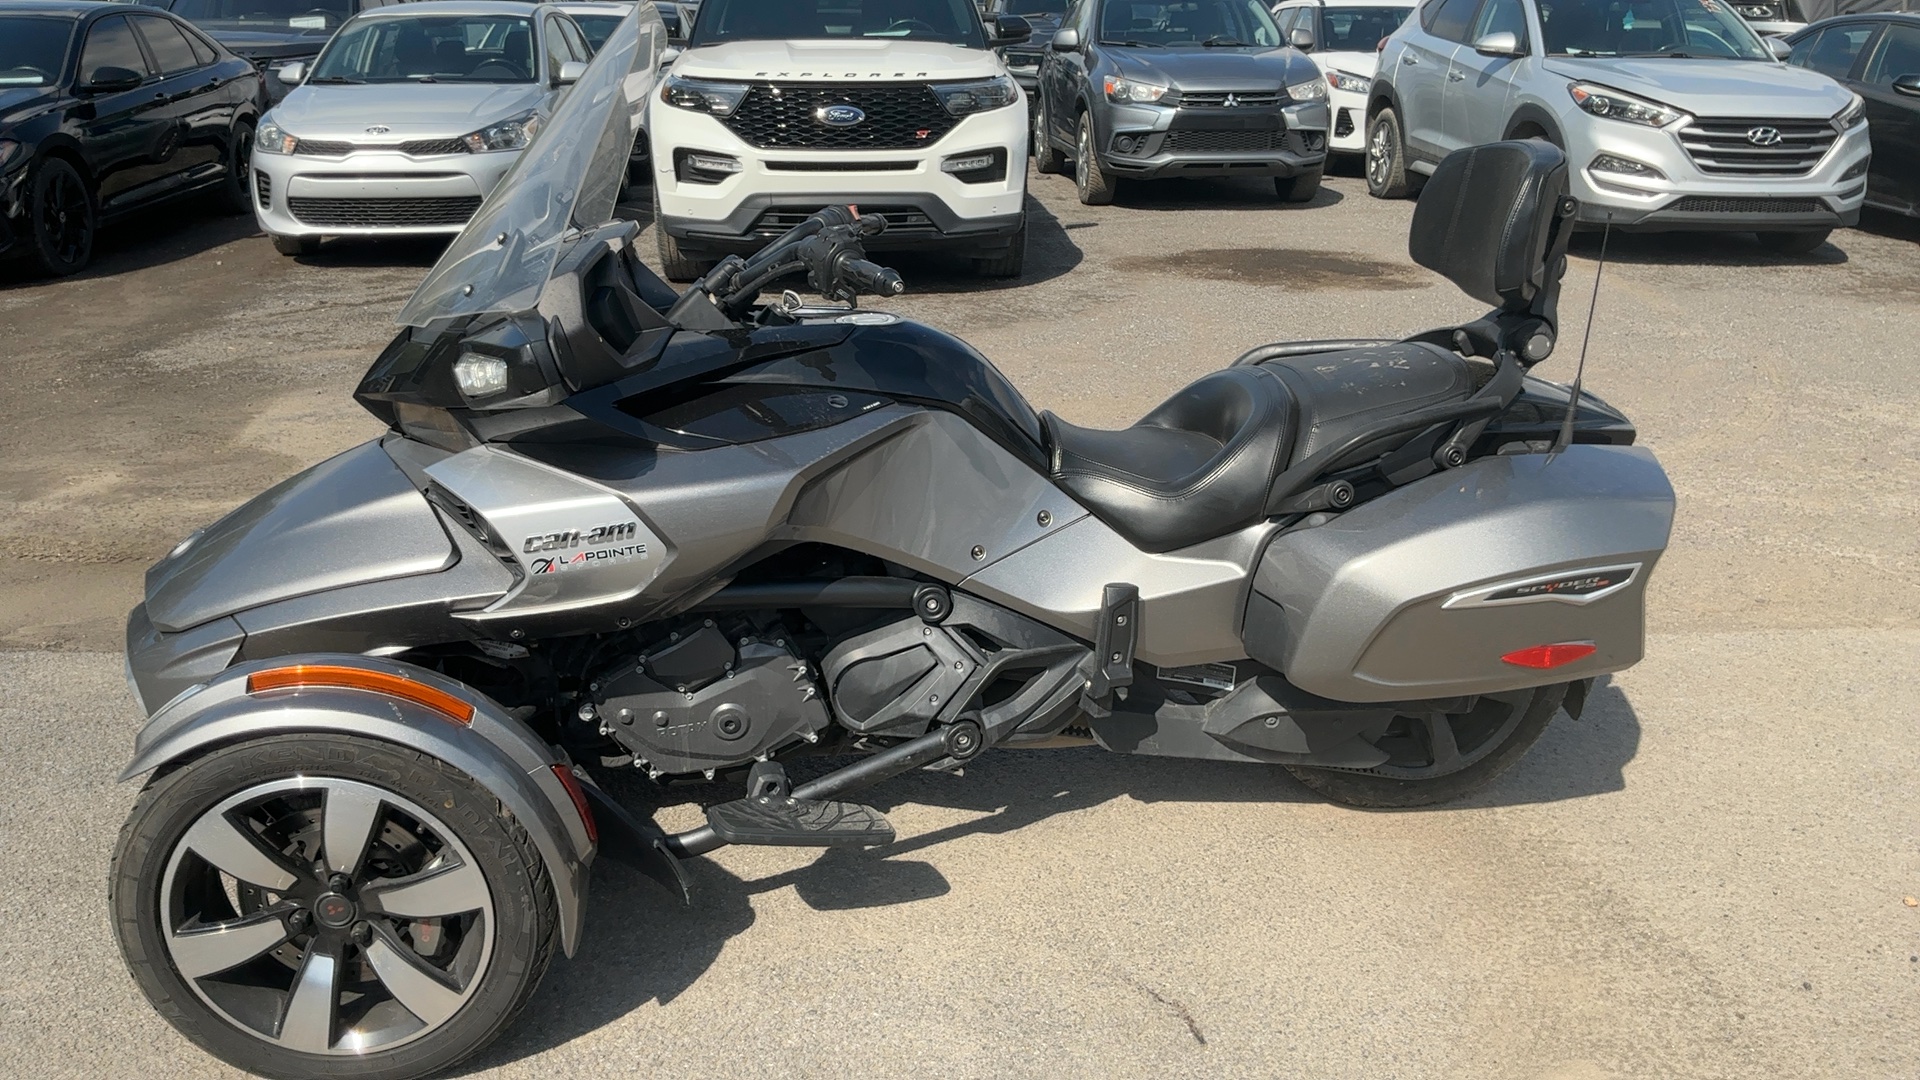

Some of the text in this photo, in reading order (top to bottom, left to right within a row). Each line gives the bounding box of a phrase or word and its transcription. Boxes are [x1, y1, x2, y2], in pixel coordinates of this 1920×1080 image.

[754, 71, 929, 79] EXPLORER
[827, 109, 855, 121] Ford
[523, 521, 637, 554] can-am
[559, 544, 647, 565] LAPOINTE
[1516, 577, 1600, 593] SPYDER
[656, 720, 707, 739] ROTAX
